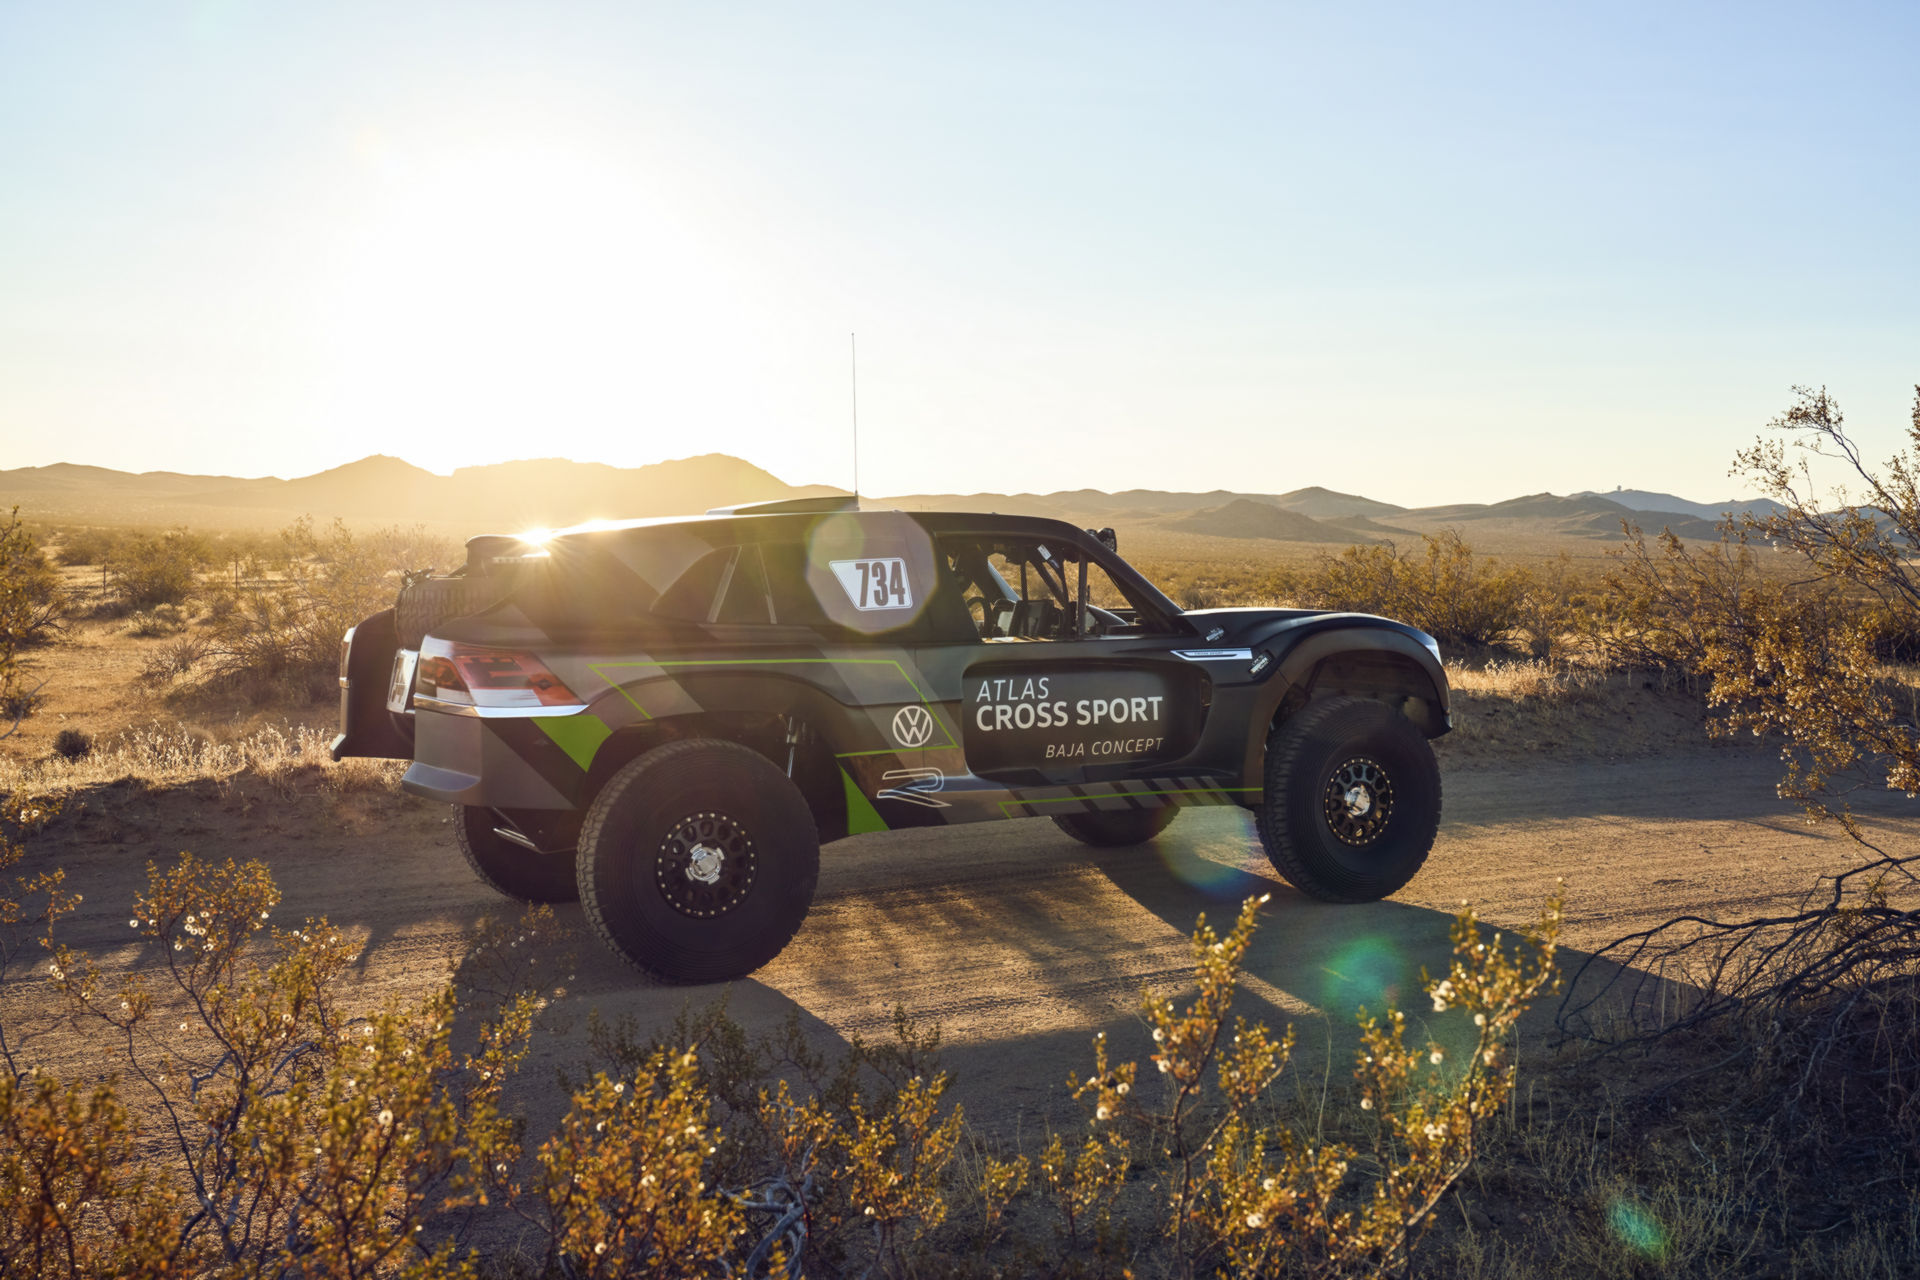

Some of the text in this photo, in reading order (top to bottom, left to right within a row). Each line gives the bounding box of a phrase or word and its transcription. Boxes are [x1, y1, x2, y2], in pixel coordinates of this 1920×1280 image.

[855, 561, 905, 607] 734
[976, 677, 1050, 702] ATLAS
[976, 696, 1163, 731] CROSS SPORT
[1045, 737, 1164, 758] BAJA CONCEPT
